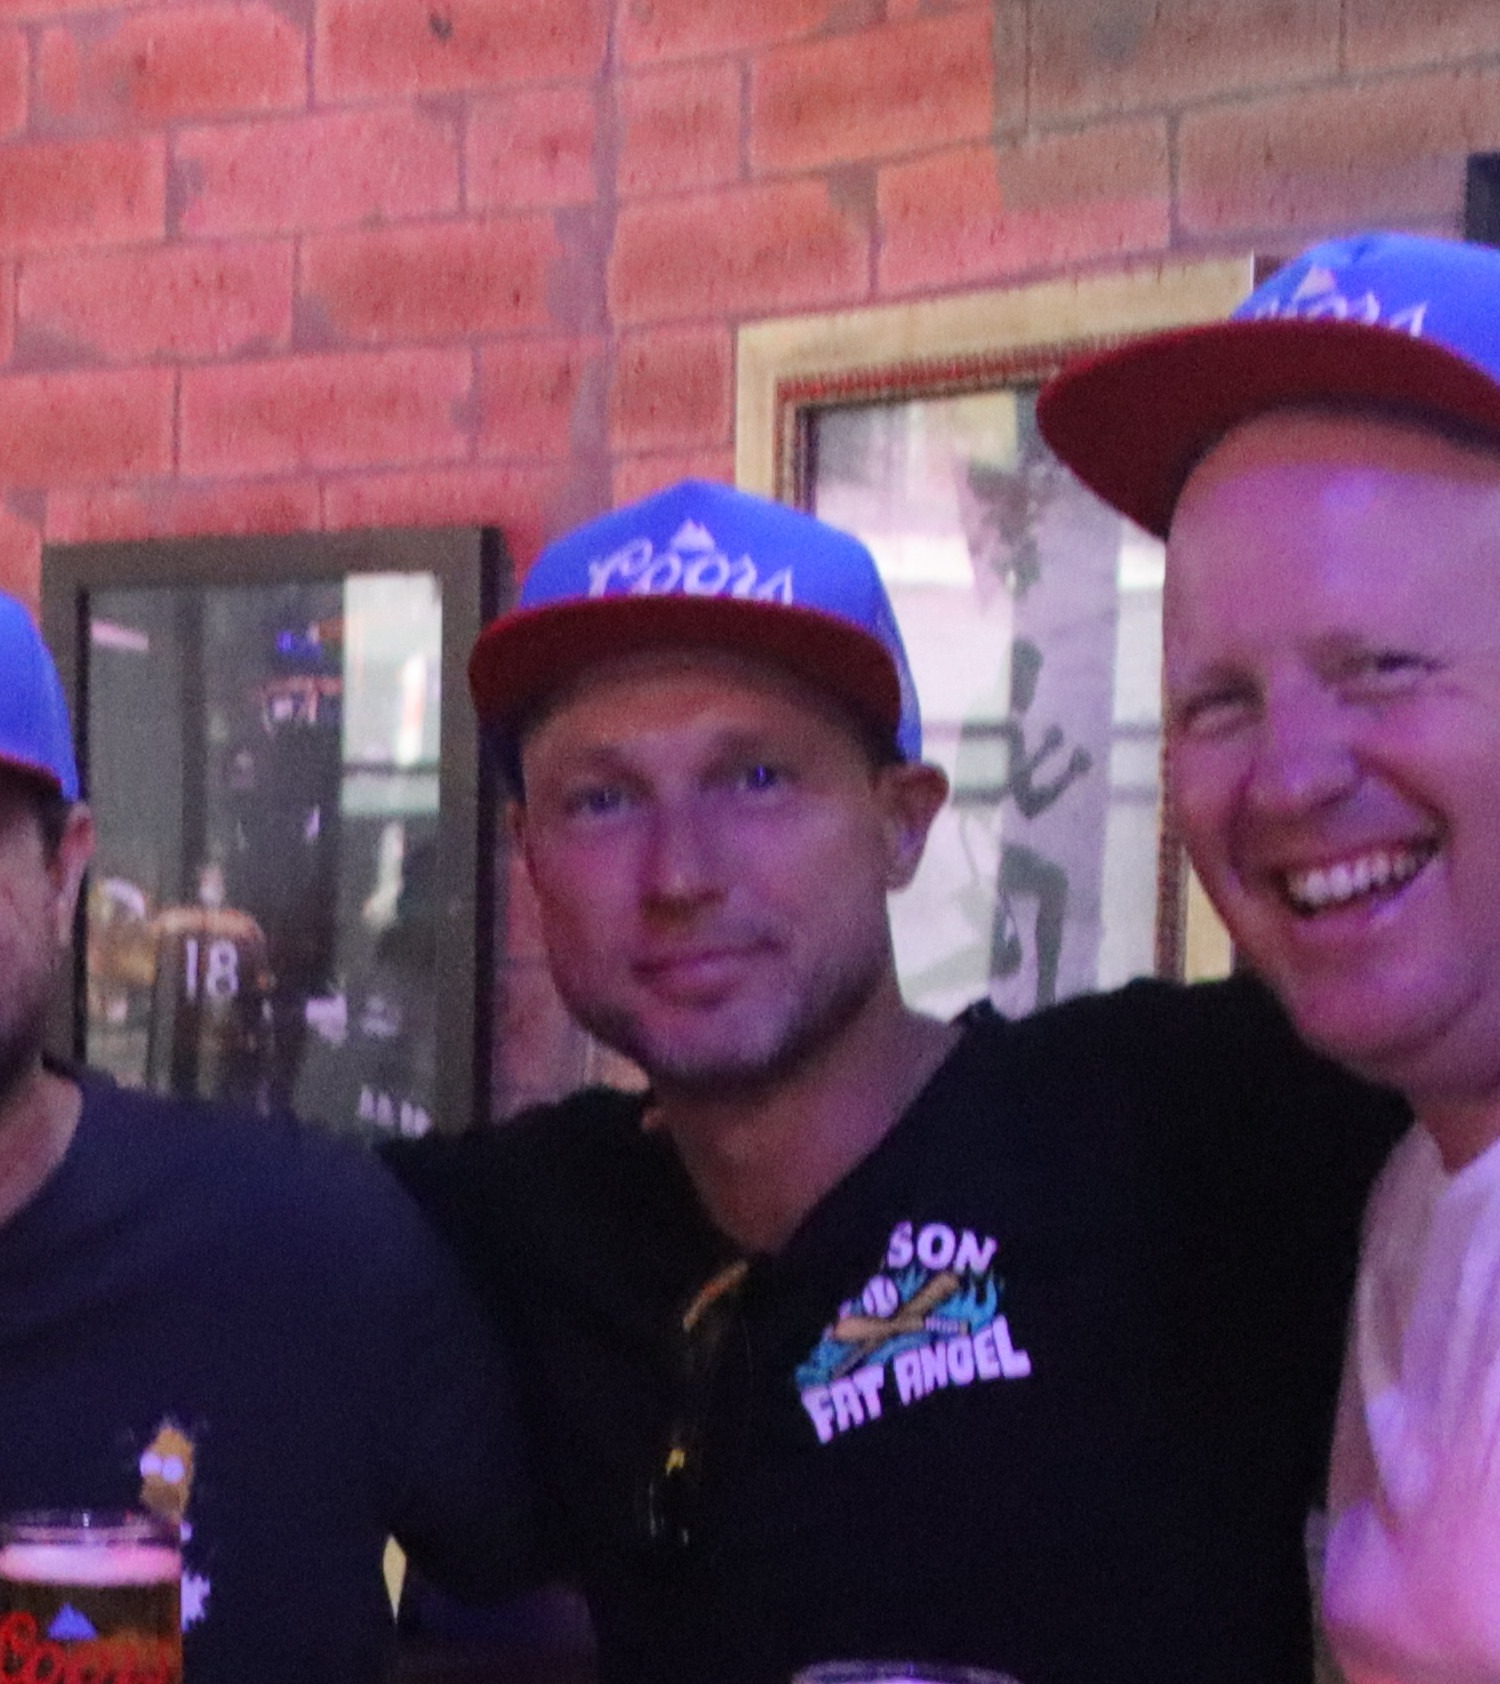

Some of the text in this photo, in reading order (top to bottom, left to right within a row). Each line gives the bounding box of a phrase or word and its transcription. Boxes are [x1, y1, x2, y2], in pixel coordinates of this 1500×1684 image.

[186, 937, 240, 1001] 18
[886, 1220, 999, 1273] SON
[800, 1364, 886, 1446] FAT
